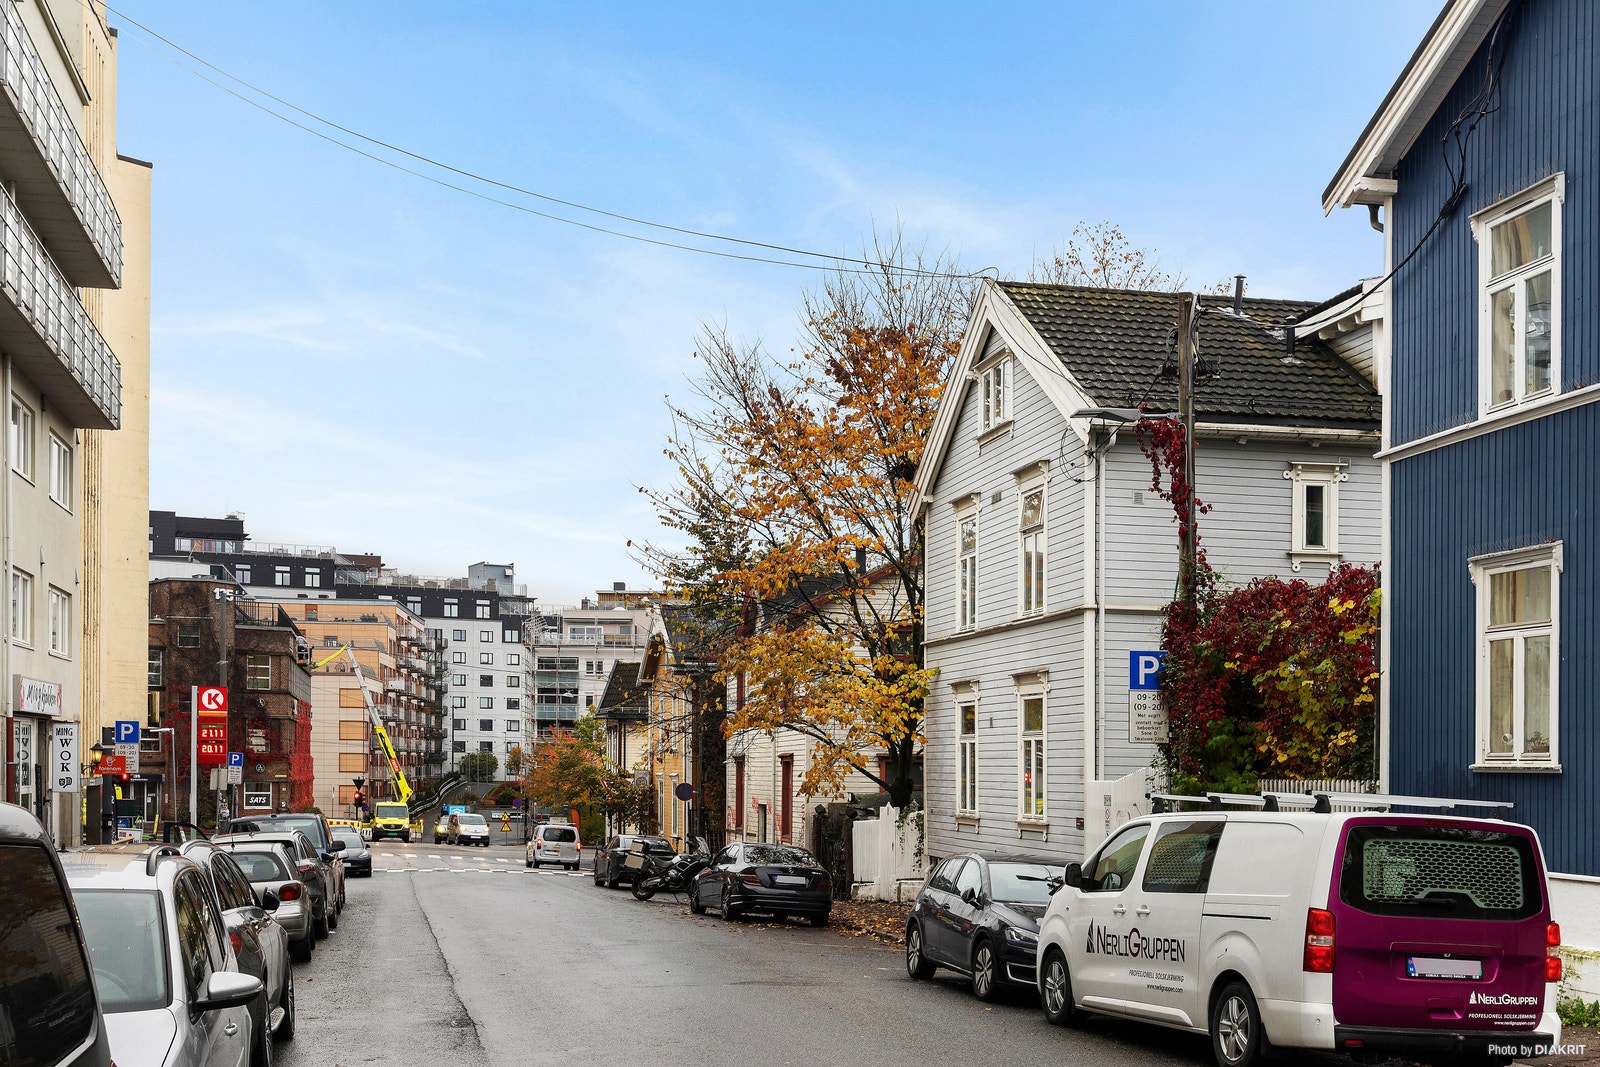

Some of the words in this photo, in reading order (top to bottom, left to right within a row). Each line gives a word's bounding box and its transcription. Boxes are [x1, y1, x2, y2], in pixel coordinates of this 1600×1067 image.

[1139, 656, 1160, 685] P
[55, 727, 73, 736] MING
[121, 724, 133, 740] P
[59, 738, 73, 772] WOK
[231, 754, 240, 765] P
[249, 796, 267, 804] SATS
[1129, 969, 1155, 979] PROFESJONELL
[1155, 972, 1185, 983] SOLSKJERMING
[1146, 984, 1184, 993] www.nerligruppen.com
